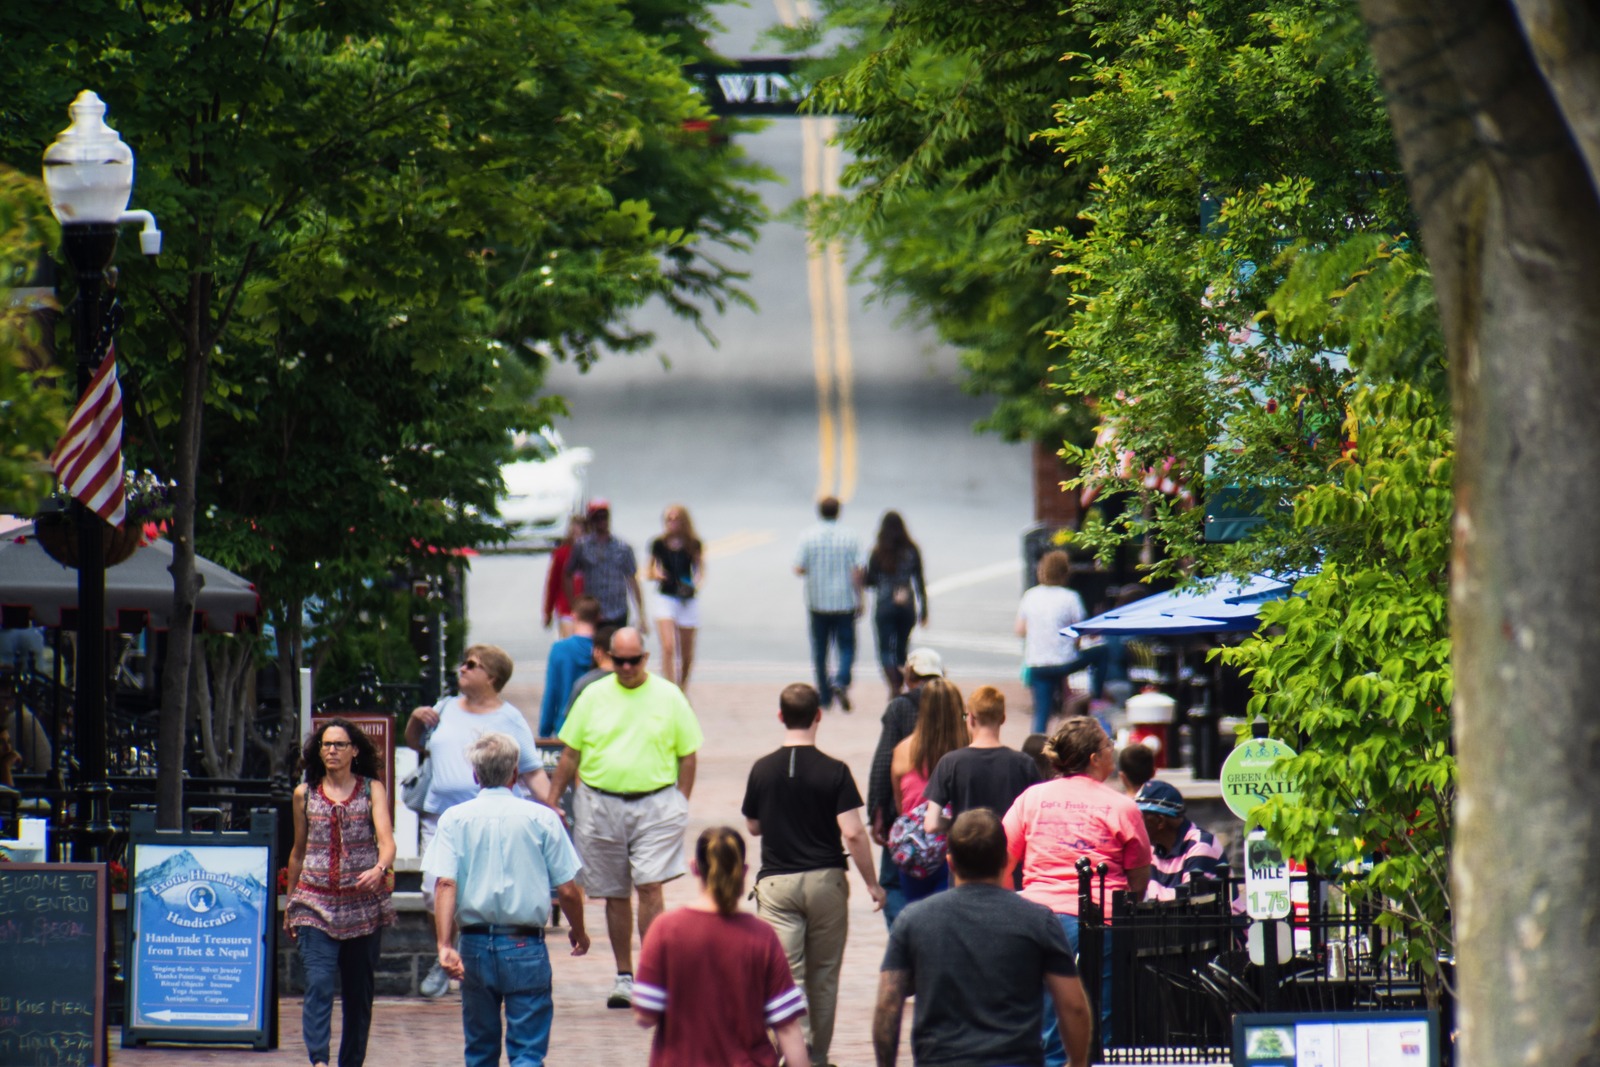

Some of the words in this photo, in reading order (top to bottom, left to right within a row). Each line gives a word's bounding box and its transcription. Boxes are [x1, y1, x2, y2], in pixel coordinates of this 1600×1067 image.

[1227, 772, 1262, 782] GREEN
[1228, 781, 1295, 797] TRAIL
[1251, 867, 1284, 880] MILE
[0, 874, 71, 893] ELCOME
[76, 874, 96, 890] TO
[150, 873, 188, 896] Exotic
[190, 869, 252, 898] Himalayan
[23, 895, 89, 913] CENTRO
[1248, 890, 1289, 912] 1.75
[166, 910, 237, 929] Handicrafts
[145, 933, 201, 944] Handmade
[203, 934, 252, 945] Treasures
[147, 945, 173, 955] from
[176, 946, 202, 956] Tibet
[205, 948, 215, 957] &
[218, 947, 249, 959] Nepal
[16, 999, 45, 1014] KIDS
[51, 1000, 93, 1016] MEAL
